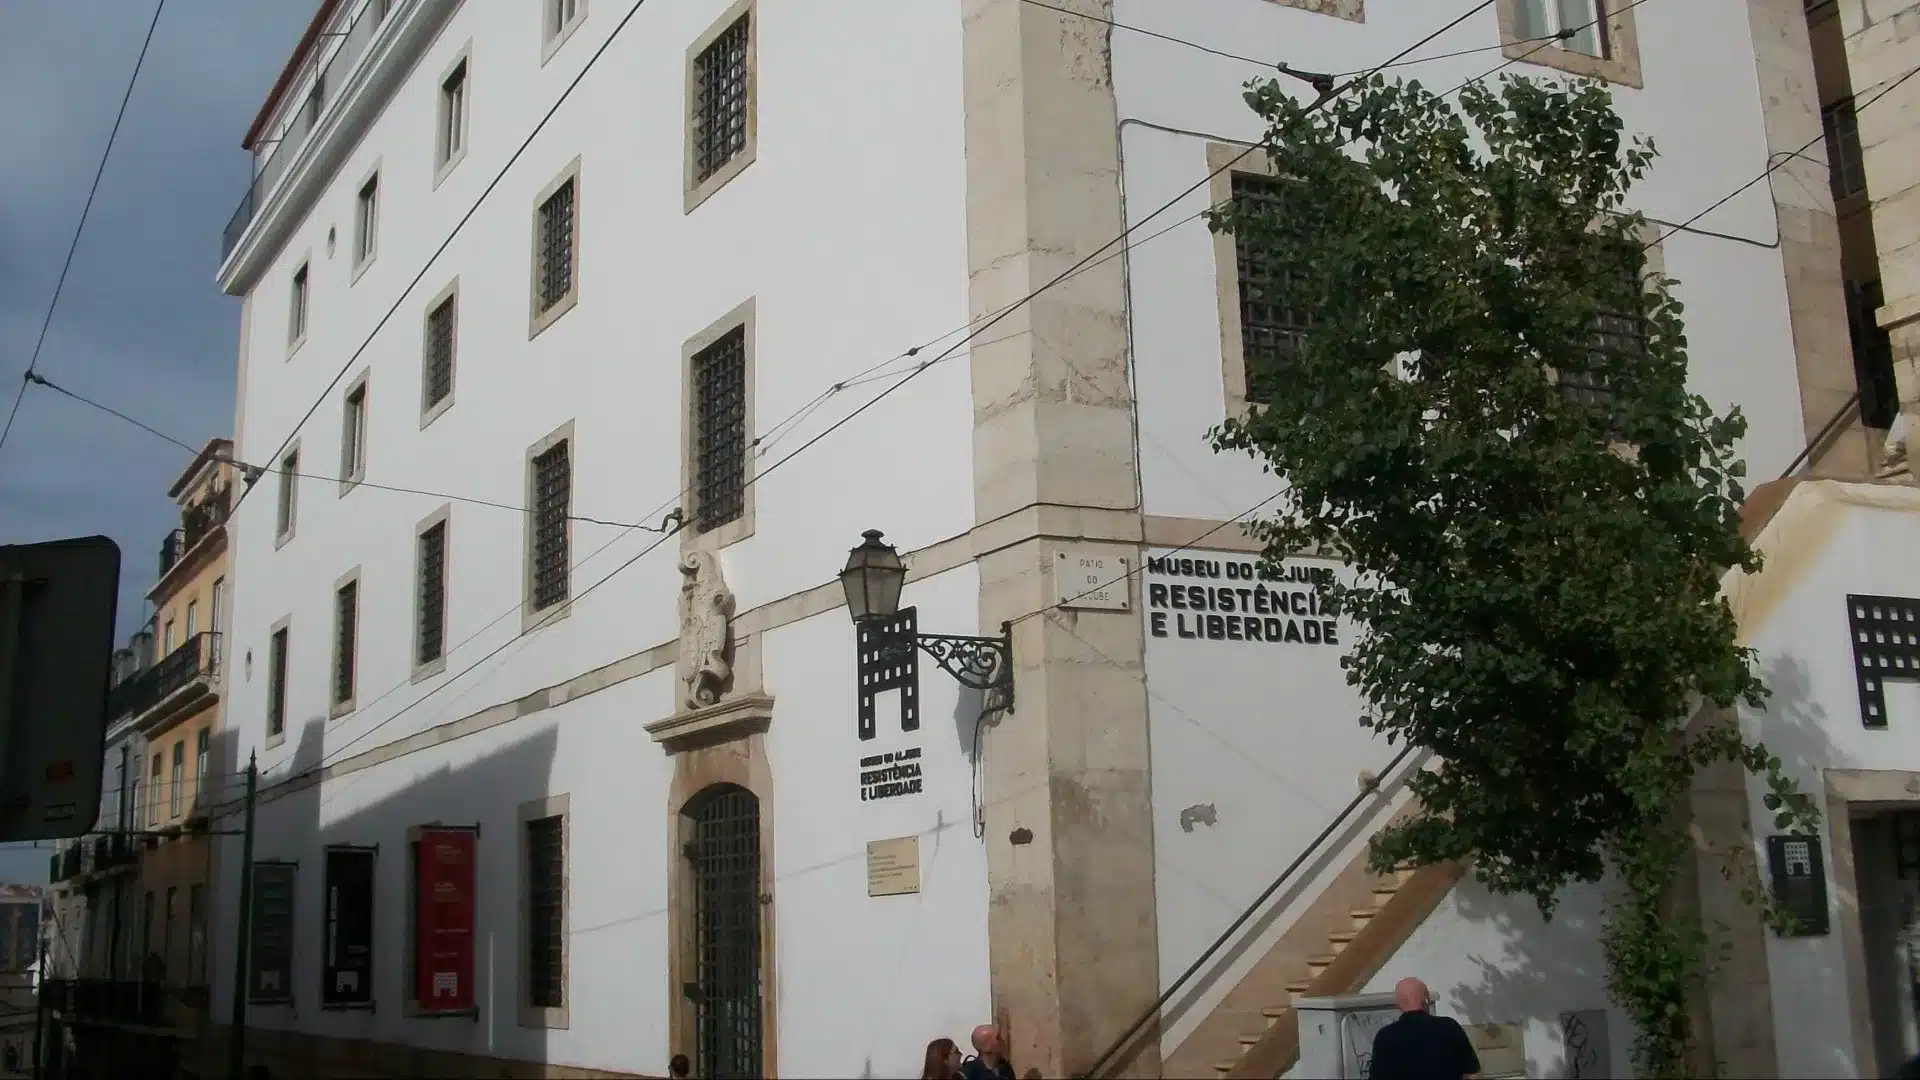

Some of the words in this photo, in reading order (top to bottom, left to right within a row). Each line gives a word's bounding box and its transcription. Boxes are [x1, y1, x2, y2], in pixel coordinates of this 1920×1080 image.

[1148, 556, 1221, 579] MUSEU
[1226, 562, 1254, 581] DO
[1150, 583, 1340, 617] RESISTÊNCI
[1151, 612, 1168, 638] E
[1177, 613, 1338, 645] LIBERDADE
[861, 787, 867, 801] E
